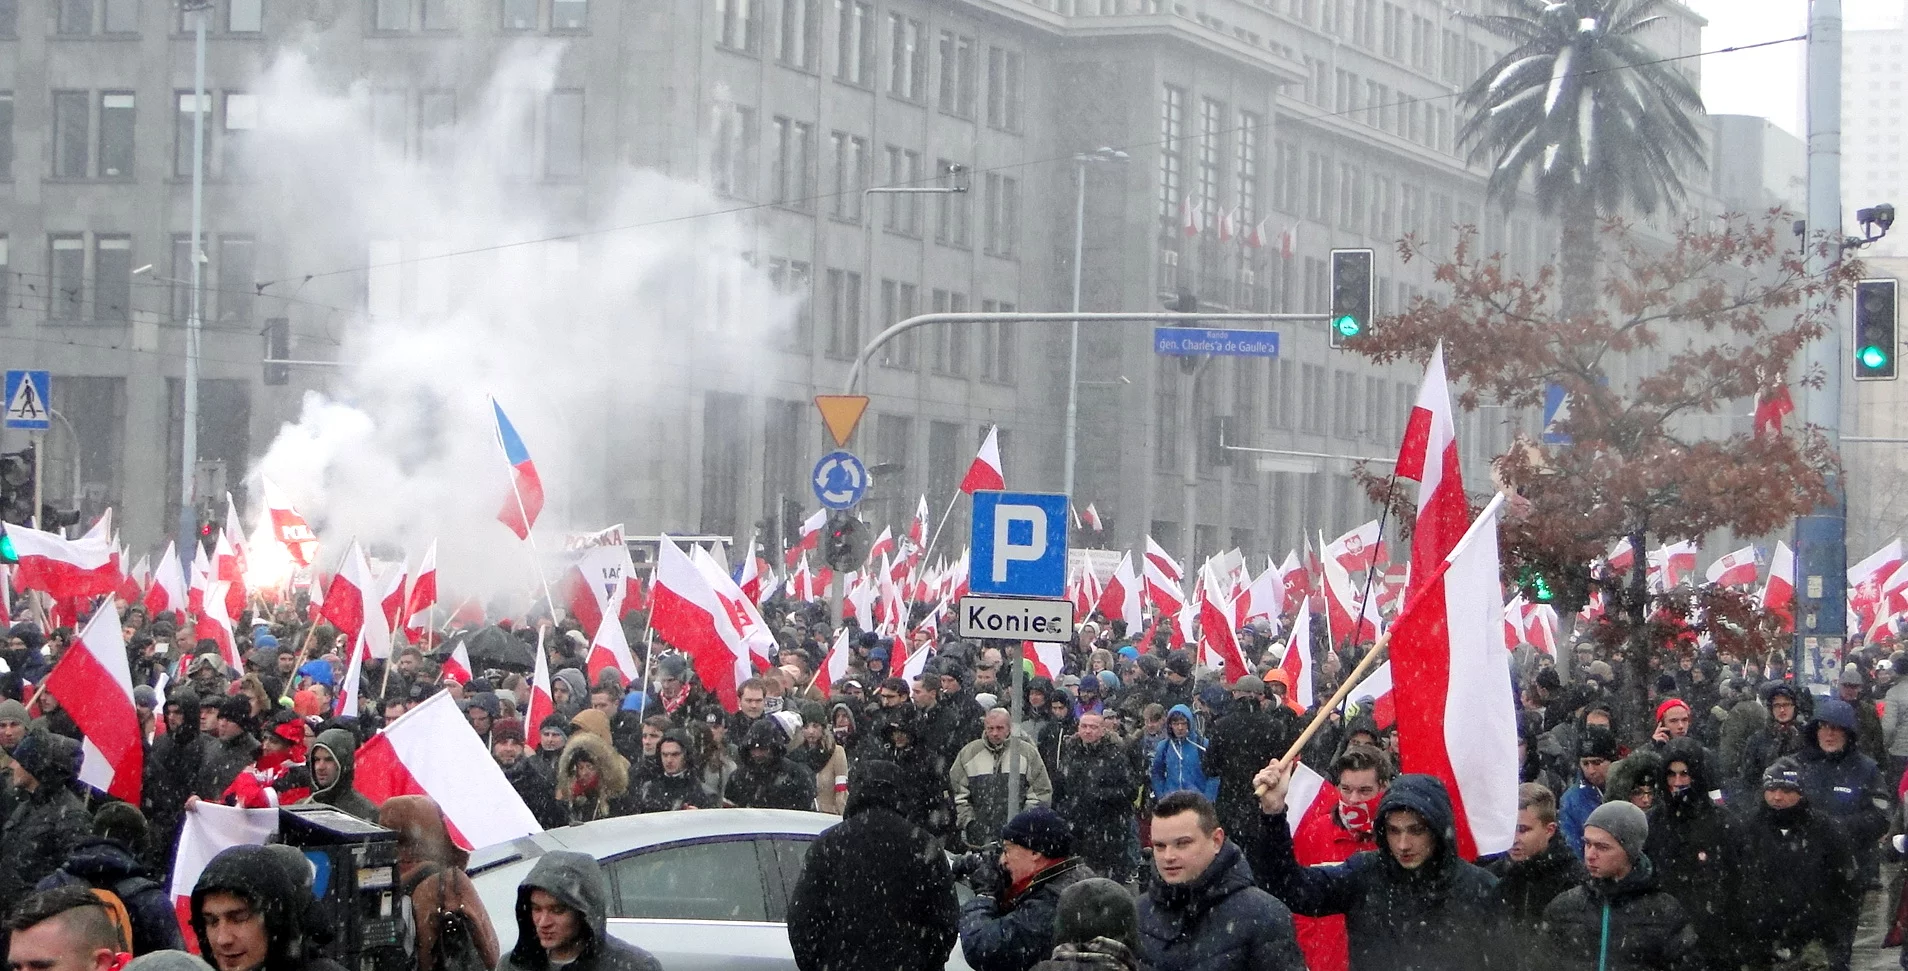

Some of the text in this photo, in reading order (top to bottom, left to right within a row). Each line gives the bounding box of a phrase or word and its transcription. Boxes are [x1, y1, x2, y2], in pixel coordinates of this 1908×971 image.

[1159, 340, 1179, 351] gen.
[1224, 341, 1236, 351] de
[992, 504, 1047, 582] P
